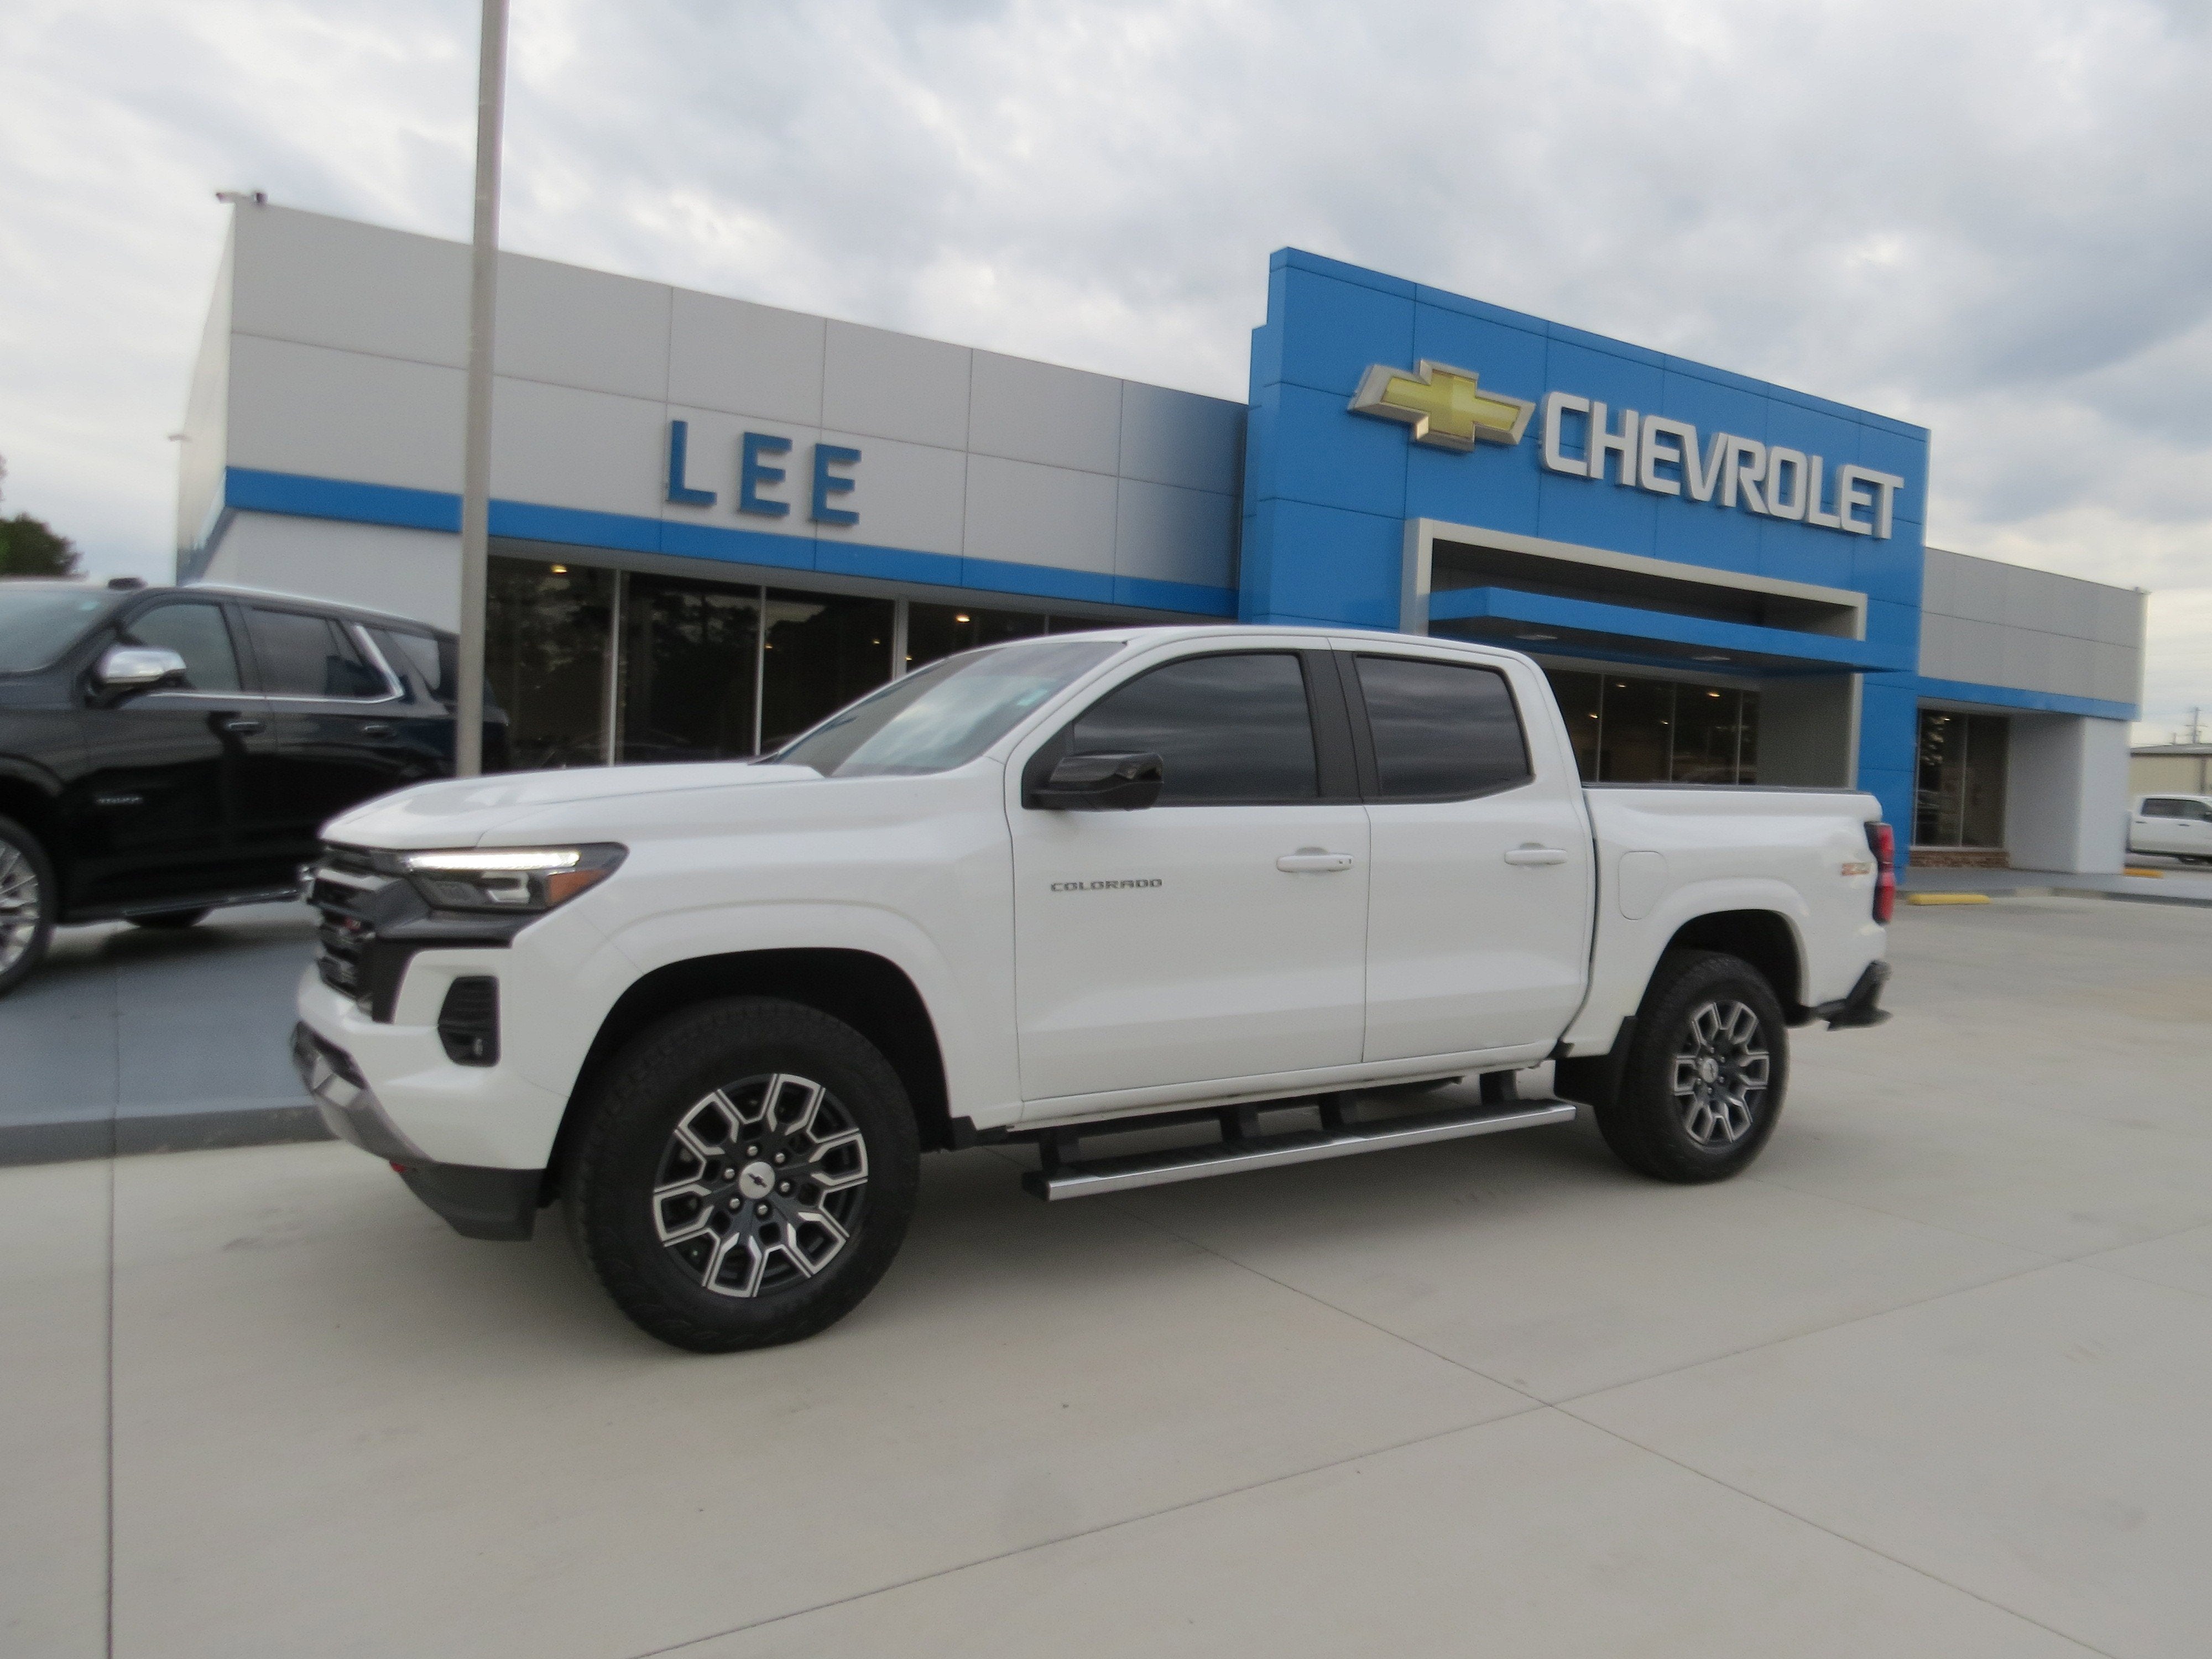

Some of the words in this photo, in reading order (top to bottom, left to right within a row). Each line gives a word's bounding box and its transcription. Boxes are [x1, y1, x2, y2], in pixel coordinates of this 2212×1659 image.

[667, 419, 862, 525] LEE
[1541, 391, 1905, 540] CHEVROLET
[1051, 878, 1163, 892] COLORADO
